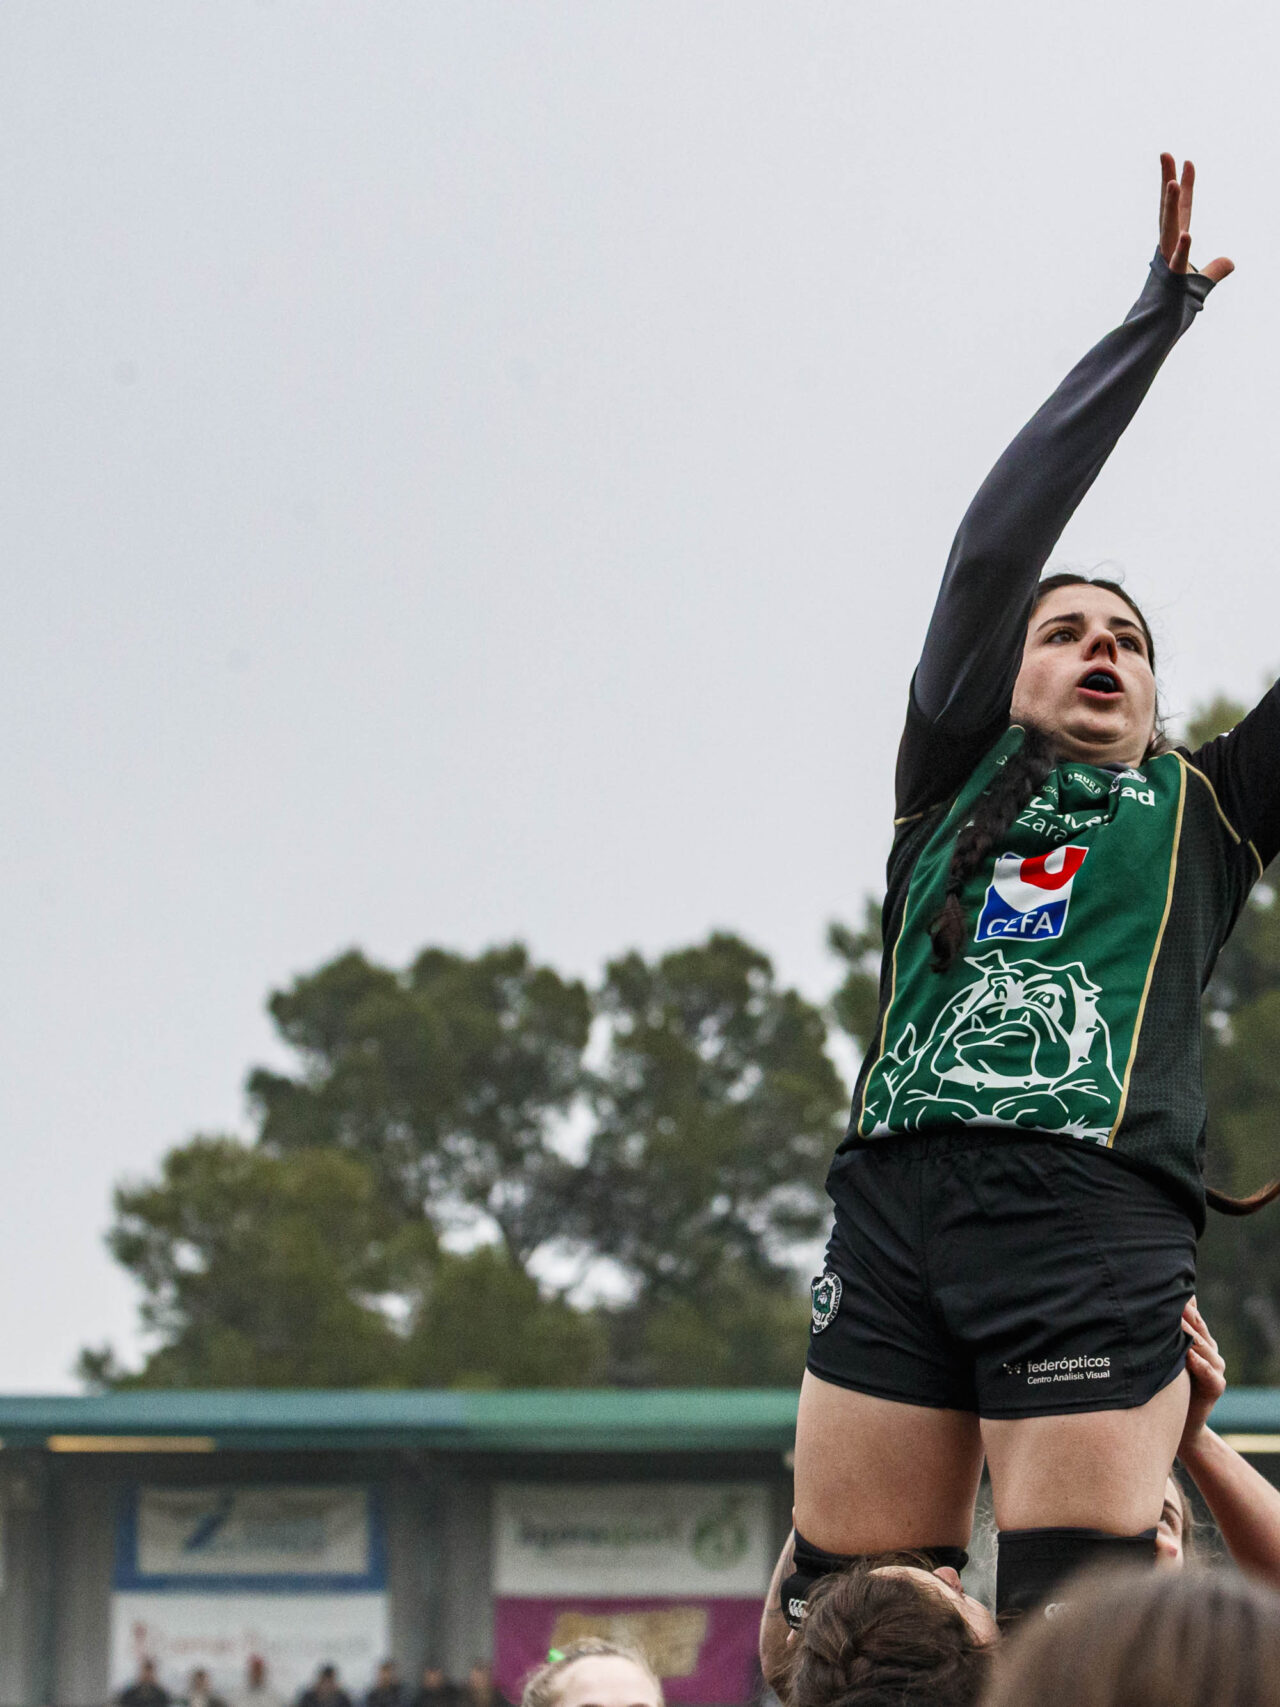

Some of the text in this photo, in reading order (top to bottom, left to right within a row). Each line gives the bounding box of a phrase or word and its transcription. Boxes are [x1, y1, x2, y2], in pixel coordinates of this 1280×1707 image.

[1015, 809, 1068, 843] Zara
[986, 911, 1054, 936] CEFA
[1027, 1355, 1111, 1372] federópticos
[1027, 1369, 1110, 1385] Centro Análisis Visual
